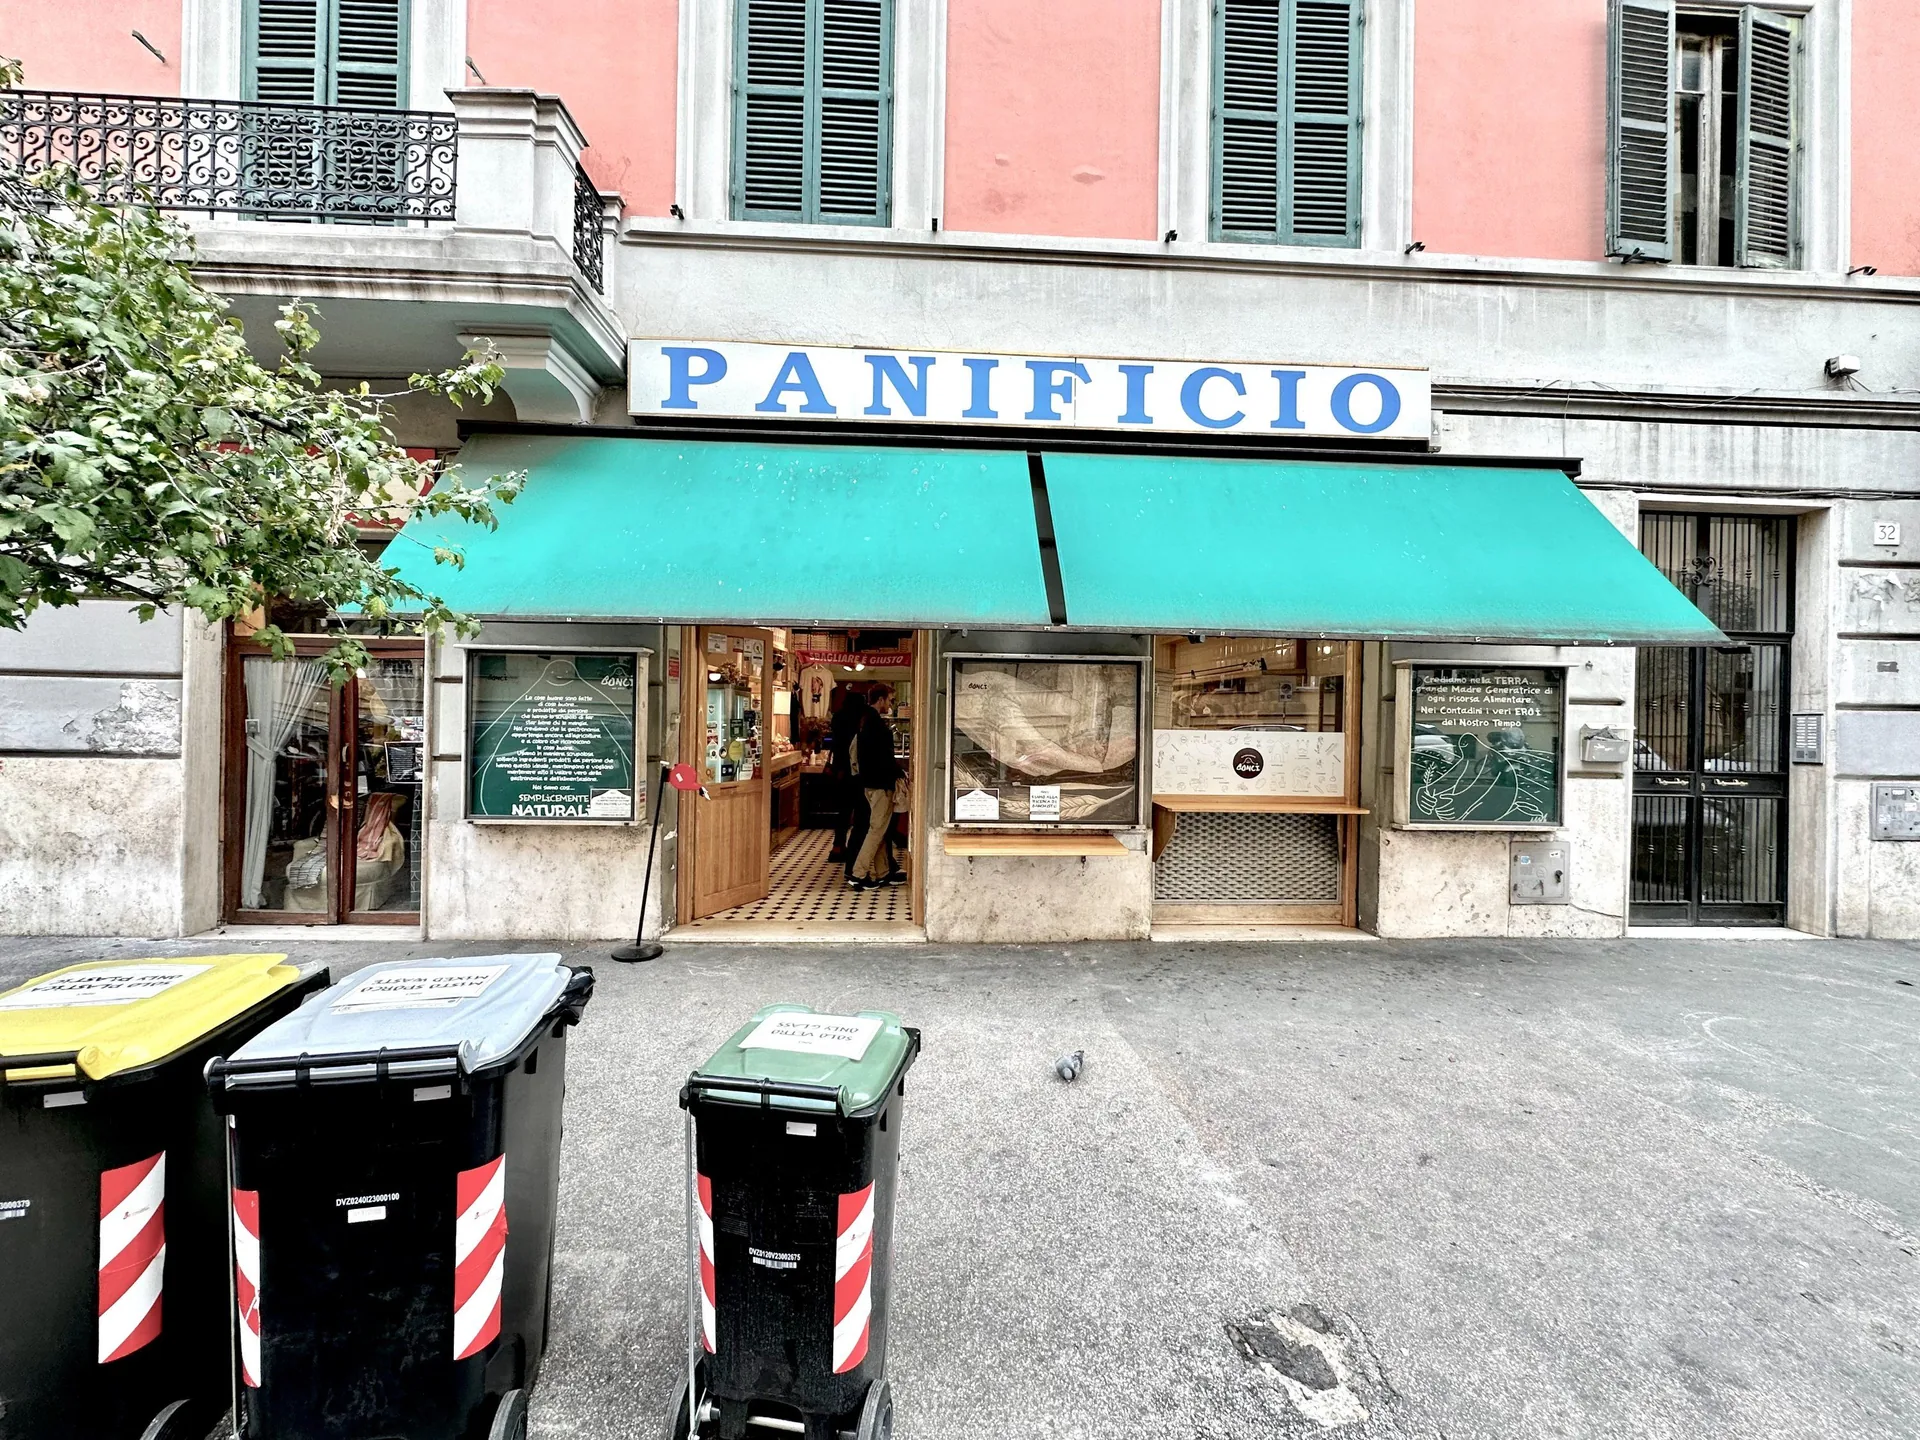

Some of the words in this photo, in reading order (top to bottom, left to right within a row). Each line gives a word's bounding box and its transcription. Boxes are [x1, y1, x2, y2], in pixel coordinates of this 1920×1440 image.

[660, 346, 1402, 434] PANIFICIO
[1878, 525, 1896, 540] 32
[809, 652, 860, 664] SBAGLIARE
[870, 656, 904, 664] GIUSTO
[1423, 676, 1466, 684] Crediamo
[1486, 686, 1540, 694] Generatrice
[1428, 695, 1445, 703] ogni
[1421, 706, 1436, 714] Nei
[1492, 719, 1521, 728] Tempo
[50, 976, 134, 985] PLASTIC
[372, 977, 428, 985] WASTE
[31, 983, 123, 992] PLASTICA
[360, 984, 425, 993] SPORCO
[429, 981, 484, 989] MISTO
[777, 1022, 821, 1030] GLASS
[771, 1029, 814, 1037] VETRO
[820, 1033, 853, 1041] SOLO
